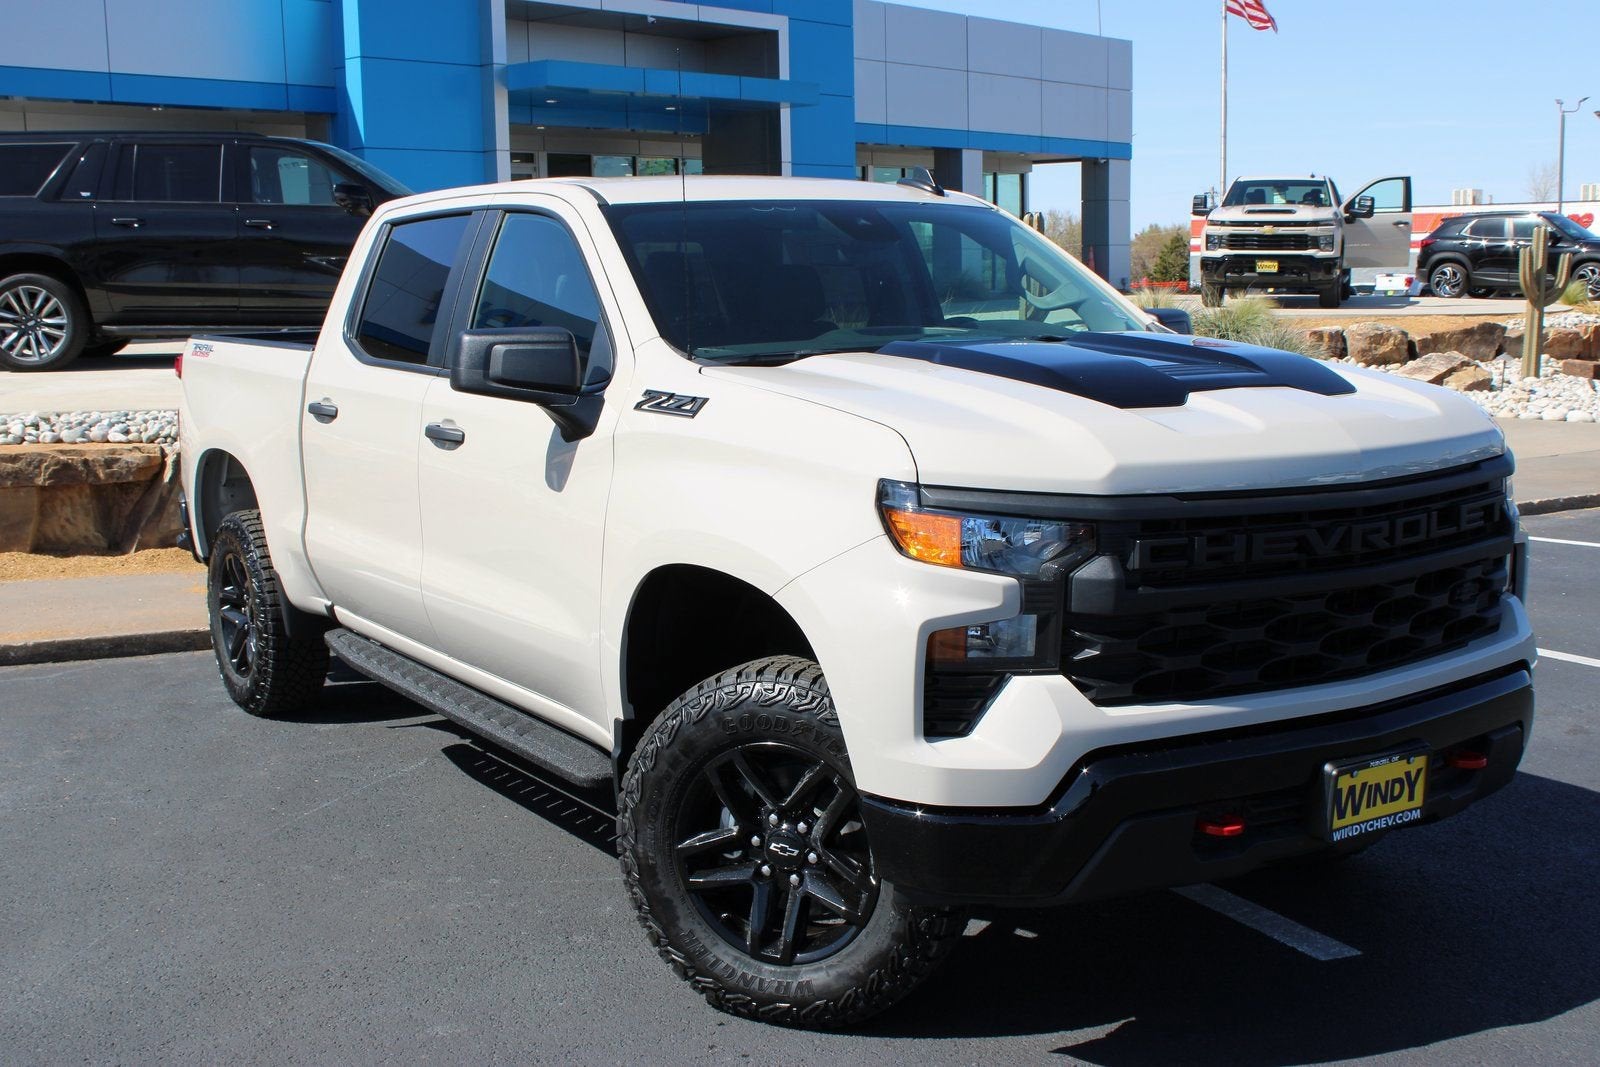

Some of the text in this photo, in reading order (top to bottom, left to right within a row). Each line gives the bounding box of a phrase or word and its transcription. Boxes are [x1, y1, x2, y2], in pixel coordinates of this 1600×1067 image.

[193, 343, 214, 352] TRAIL
[633, 389, 710, 419] Z71
[1128, 501, 1502, 571] CHEVROLET
[1335, 767, 1424, 821] WINDY
[1332, 809, 1421, 841] WINDYCHEV.COM
